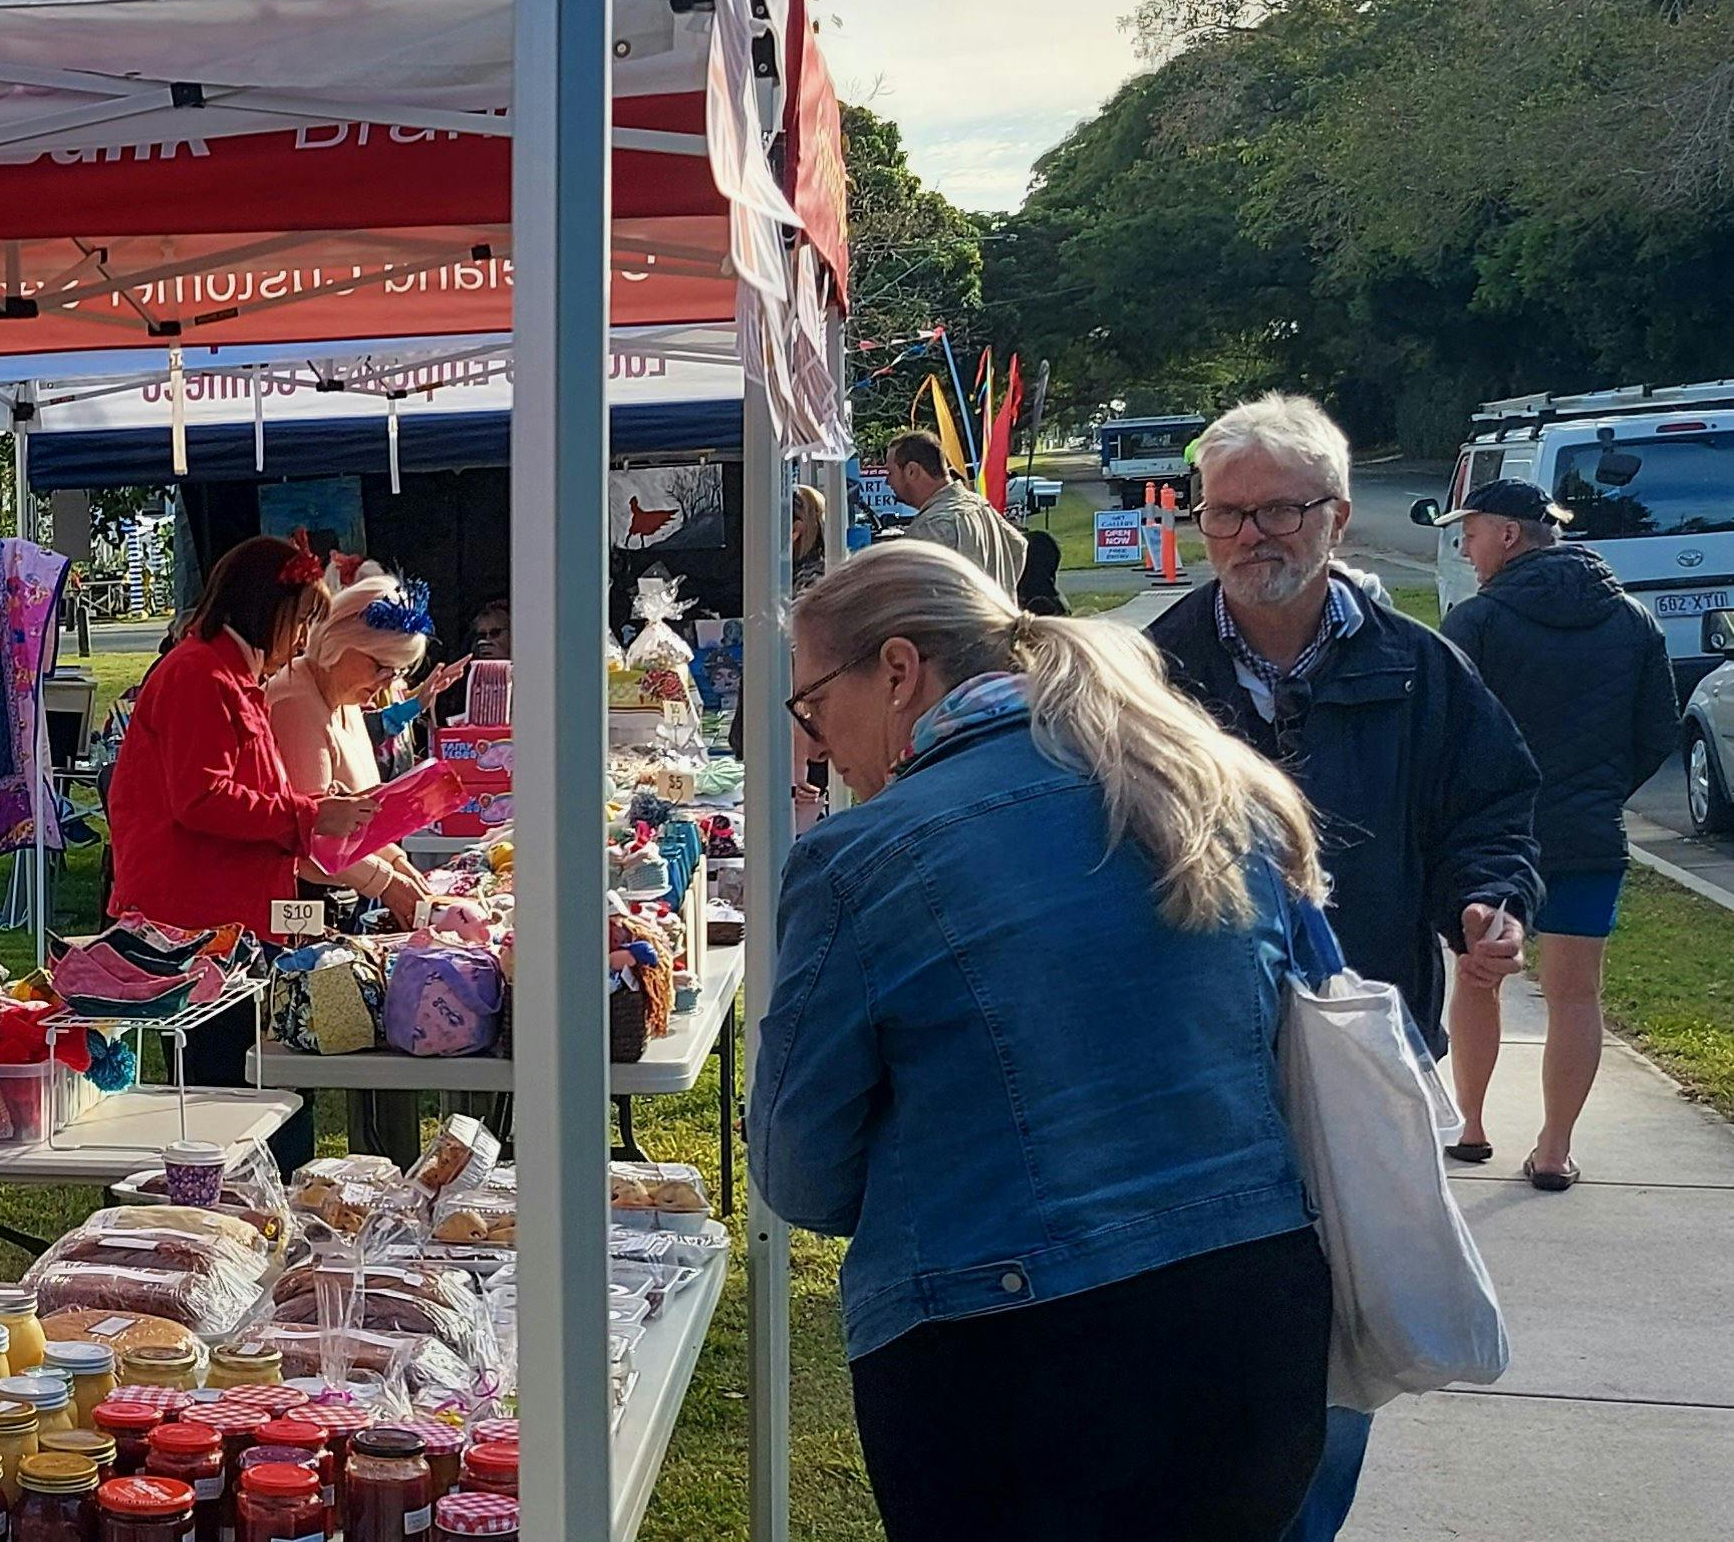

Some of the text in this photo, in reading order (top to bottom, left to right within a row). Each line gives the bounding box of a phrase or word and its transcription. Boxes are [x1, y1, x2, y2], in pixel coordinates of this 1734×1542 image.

[1105, 529, 1131, 537] OPEN
[1105, 537, 1130, 545] NOW
[668, 774, 683, 789] $5
[283, 904, 313, 919] $10
